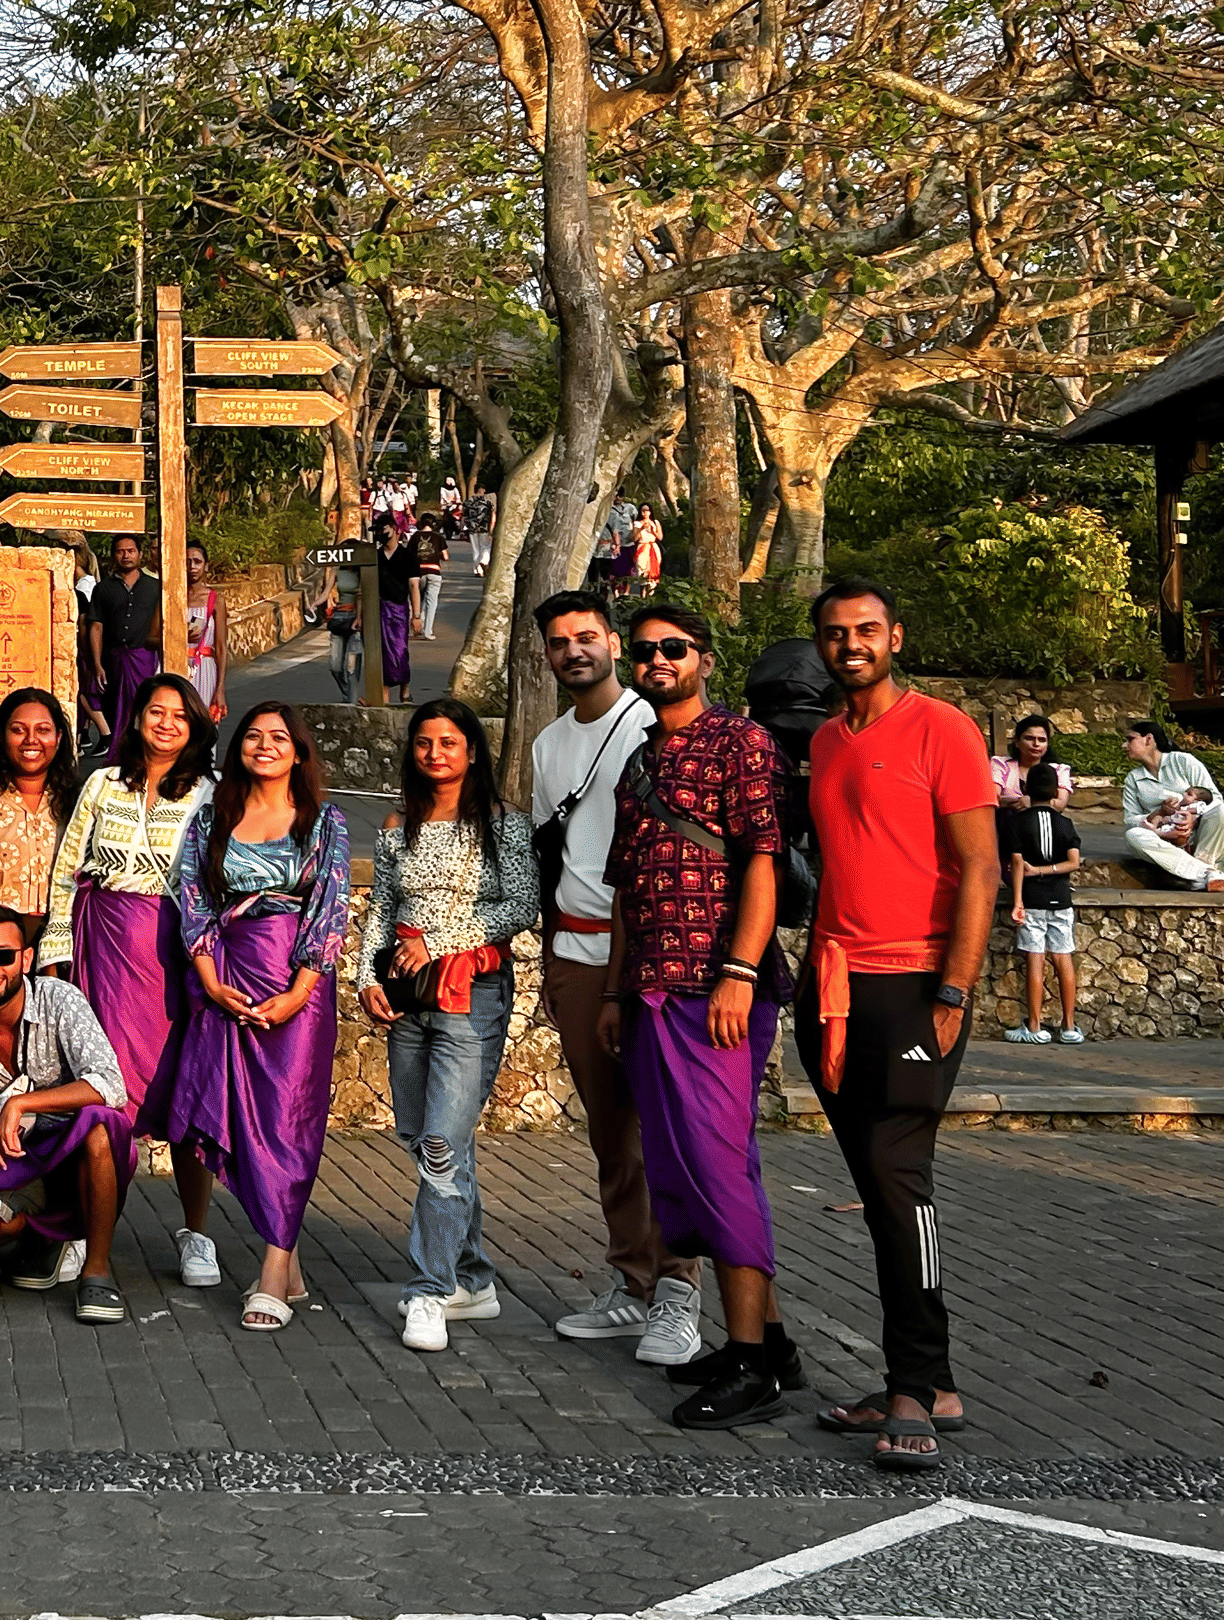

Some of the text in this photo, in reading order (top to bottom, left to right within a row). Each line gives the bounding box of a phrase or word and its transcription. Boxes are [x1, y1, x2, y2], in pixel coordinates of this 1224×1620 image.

[227, 352, 290, 361] CLIFF VIEW
[43, 360, 106, 372] TEMPLE
[240, 361, 279, 370] SOUTH
[47, 402, 103, 417] TOILET
[222, 401, 299, 411] KECAK DANCE
[226, 412, 295, 421] OPEN STAGE
[48, 456, 111, 466] CLIFF VIEW
[60, 466, 100, 475] NORTH
[61, 518, 97, 527] STATUE
[317, 548, 354, 563] EXIT
